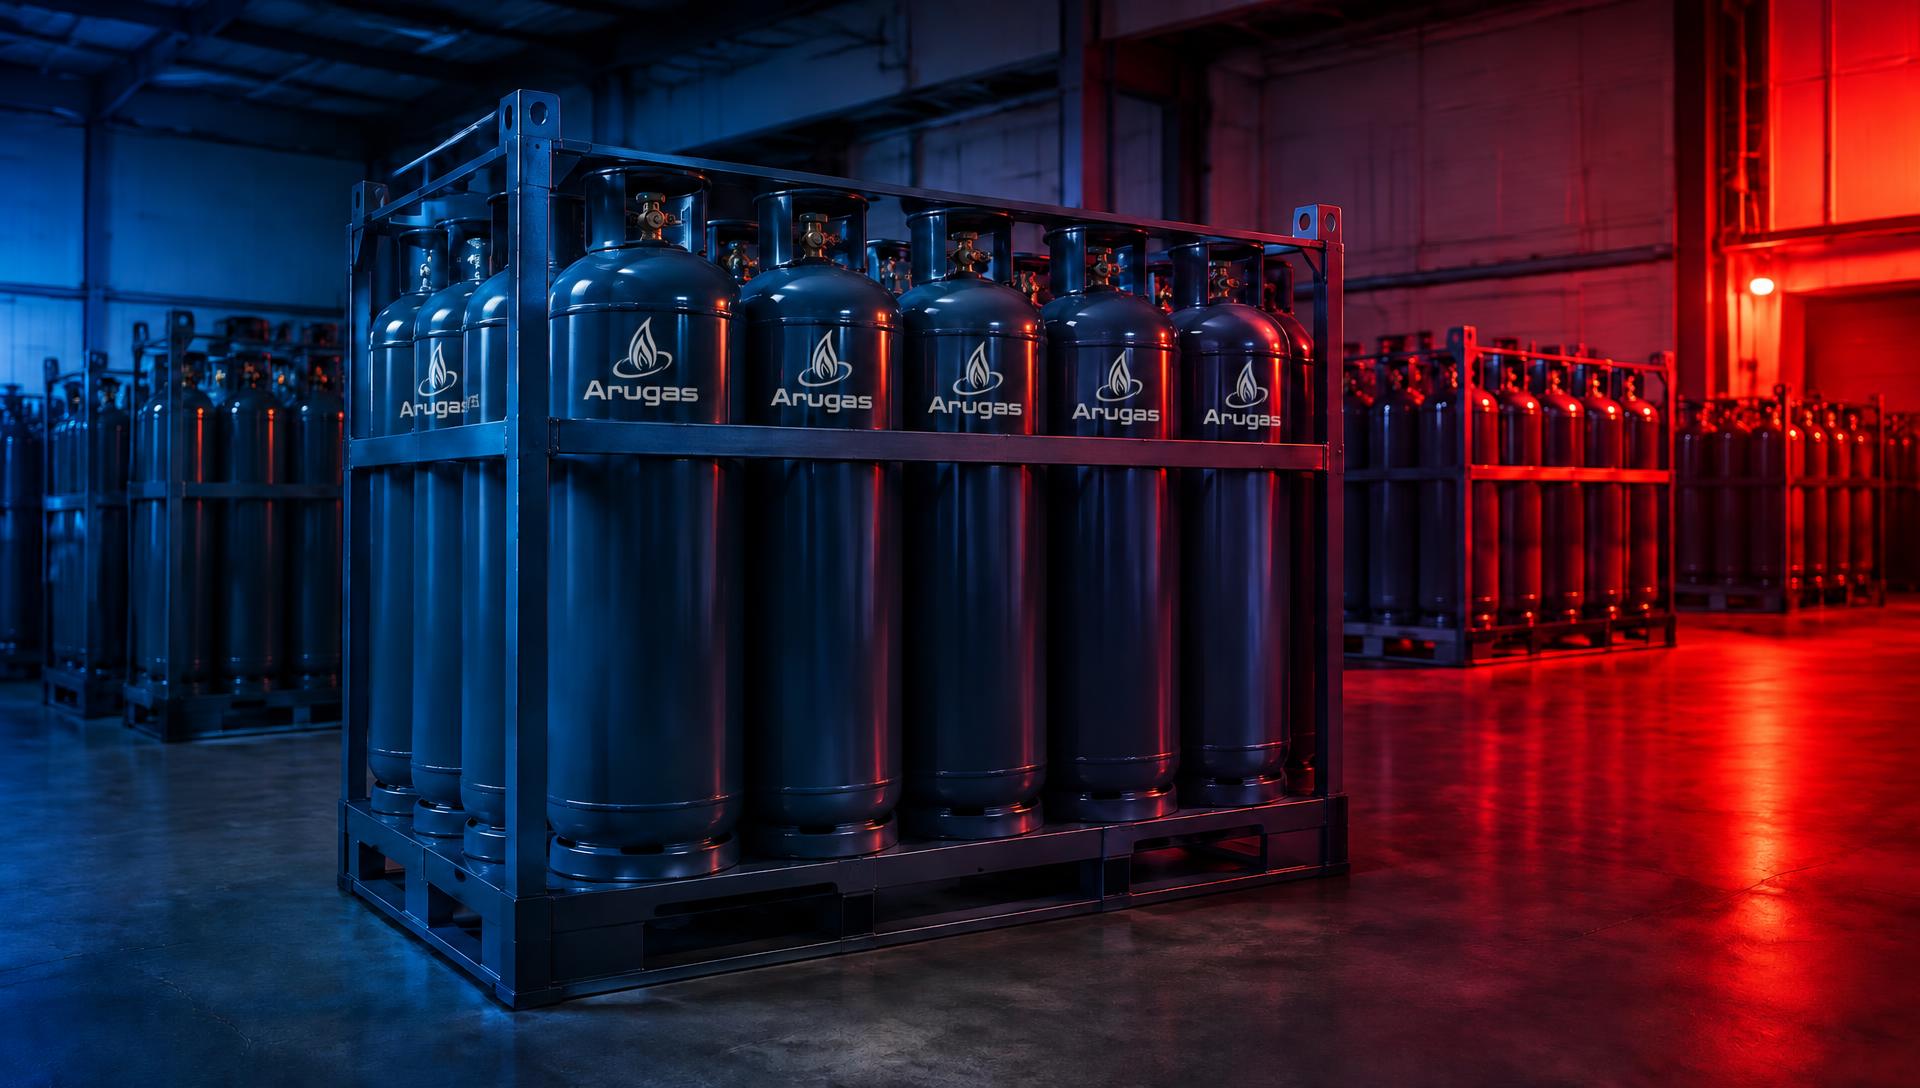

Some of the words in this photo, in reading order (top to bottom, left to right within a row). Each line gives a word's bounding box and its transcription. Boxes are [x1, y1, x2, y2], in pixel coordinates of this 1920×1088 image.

[583, 380, 699, 407] Arugas
[770, 388, 873, 413] Arugas
[399, 400, 467, 419] Arugas
[927, 396, 1023, 420] Arugas
[1071, 403, 1160, 425] Arugas
[1203, 408, 1281, 430] Arugas
